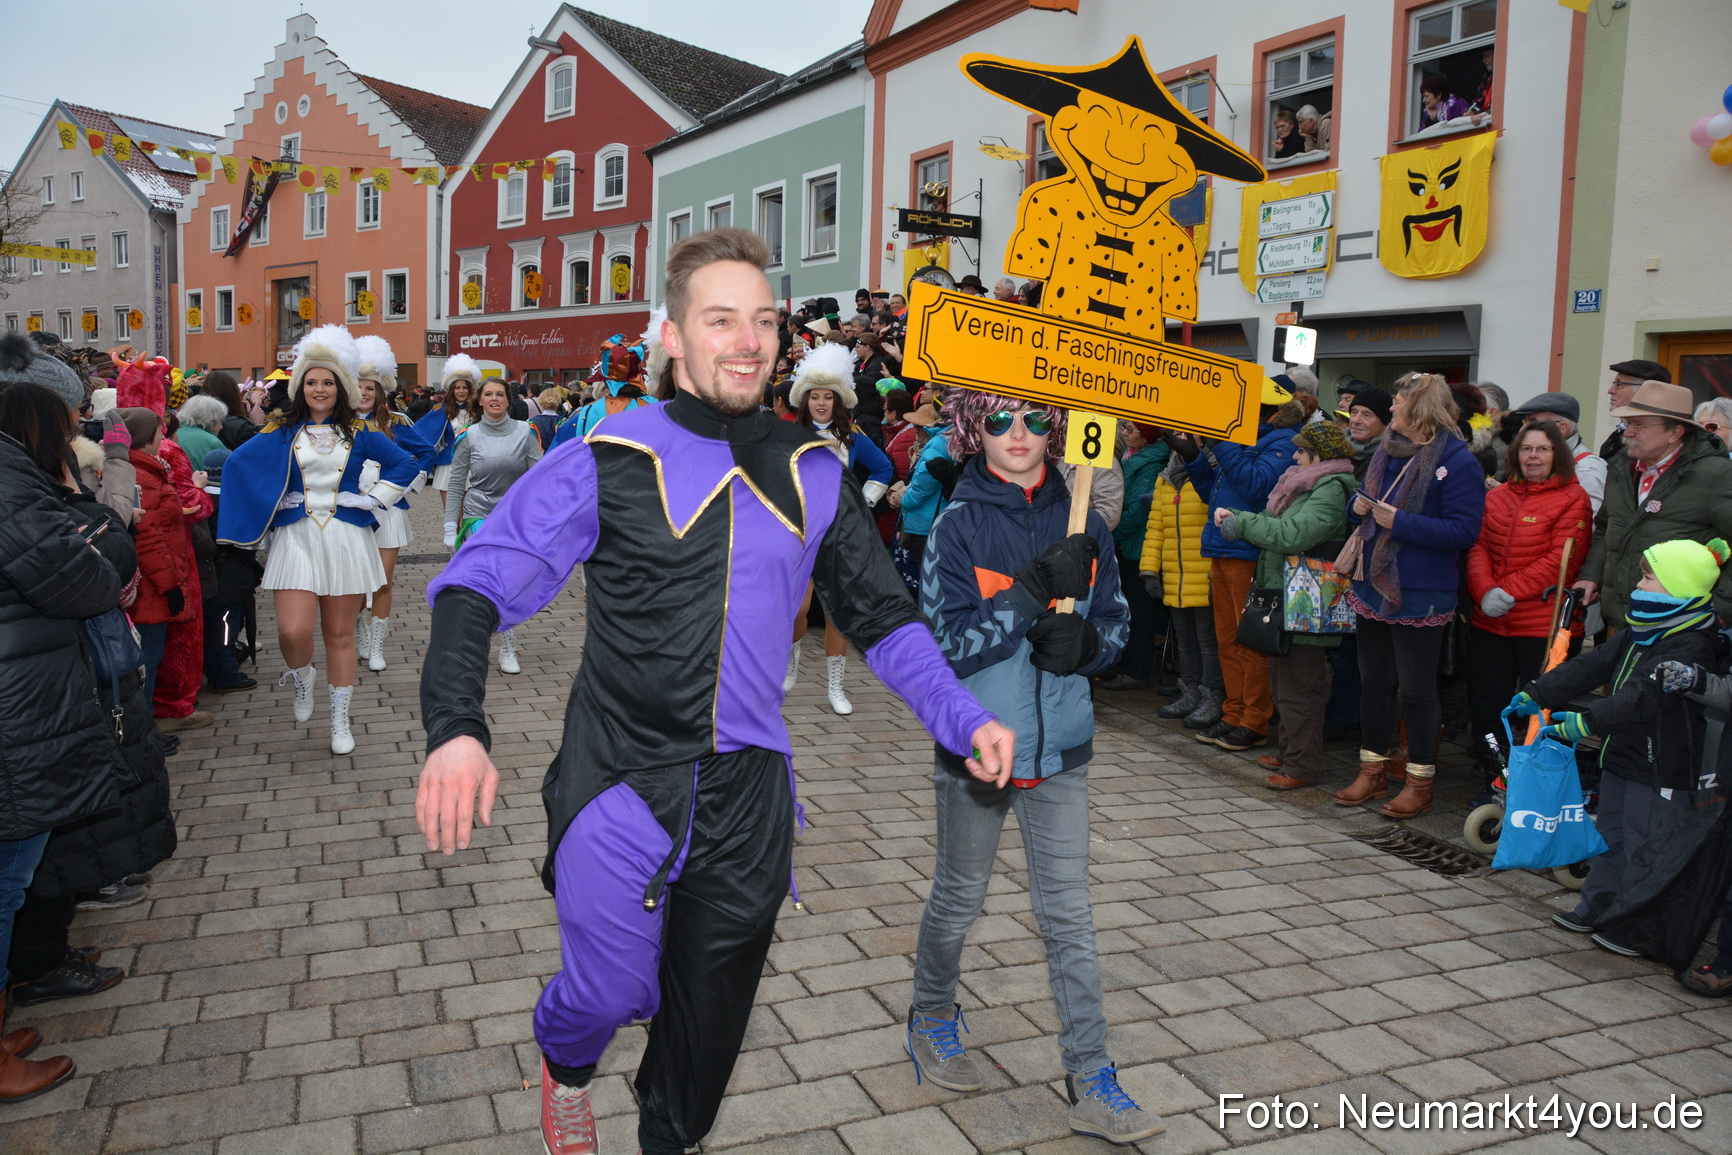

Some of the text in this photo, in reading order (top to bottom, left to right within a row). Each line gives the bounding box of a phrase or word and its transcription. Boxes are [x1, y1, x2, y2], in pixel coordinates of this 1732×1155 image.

[1272, 204, 1302, 216] Beilngries
[907, 213, 973, 229] RÖHLICH
[1272, 222, 1291, 231] Töging
[1270, 242, 1301, 253] Riedenburg
[1268, 258, 1295, 268] Mühlbach
[1269, 280, 1291, 288] Parsberg
[1268, 290, 1300, 300] Breitenbrunn
[1578, 291, 1596, 303] 20
[154, 246, 163, 357] UHREN SCHMUCK
[427, 333, 446, 344] CAFÉ
[1366, 323, 1440, 342] UHREN
[952, 307, 1222, 388] Verein d. Faschingsfreunde
[1033, 357, 1160, 404] Breitenbrunn
[1082, 421, 1102, 460] 8
